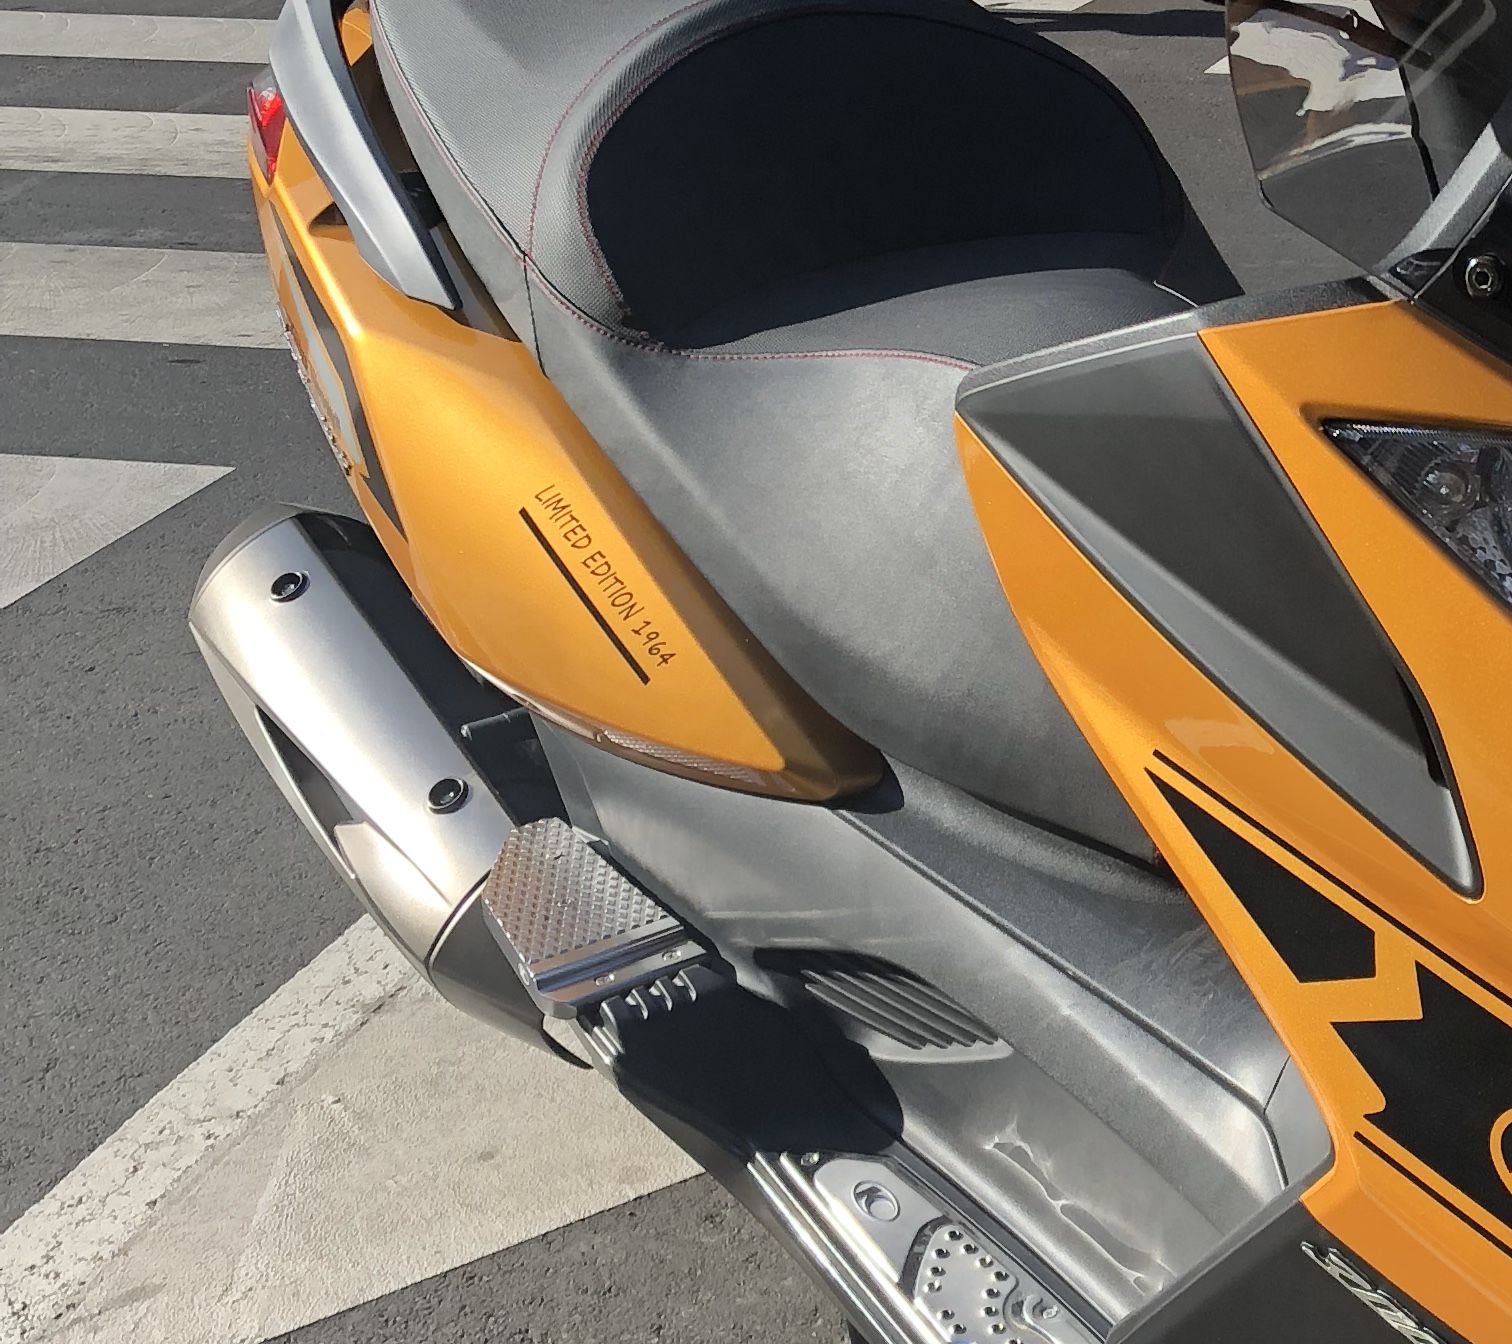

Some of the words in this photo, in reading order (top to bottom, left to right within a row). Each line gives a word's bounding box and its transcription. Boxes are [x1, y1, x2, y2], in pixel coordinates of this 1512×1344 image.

[534, 484, 592, 550] LIMITED
[580, 549, 645, 622] EDITION
[631, 619, 677, 668] 1964
